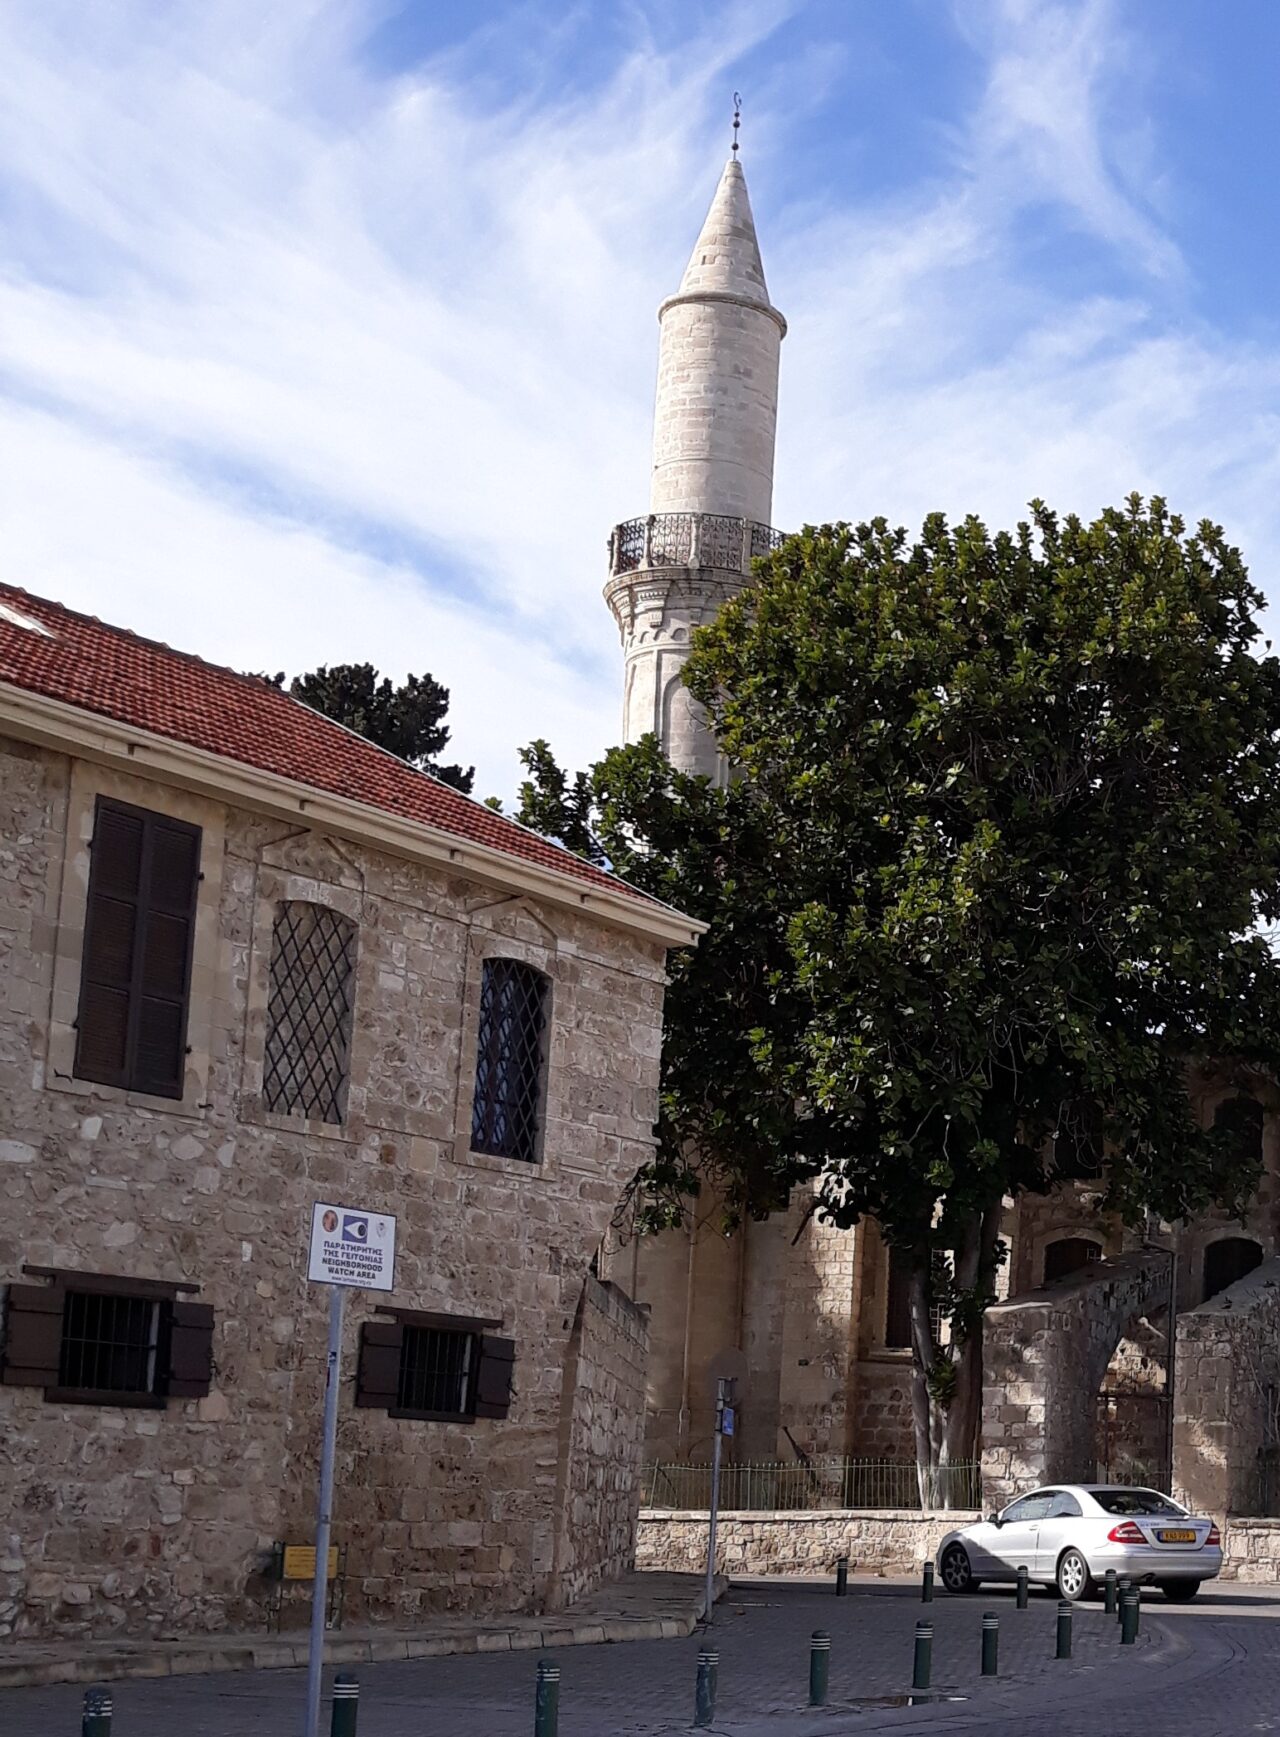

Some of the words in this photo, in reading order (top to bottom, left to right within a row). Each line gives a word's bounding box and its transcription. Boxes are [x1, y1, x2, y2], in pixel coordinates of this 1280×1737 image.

[323, 1240, 383, 1256] ΠΑΡΑΤΗΡΗΤΗΣ
[323, 1249, 339, 1258] ΤΗΣ
[341, 1252, 383, 1264] ΓΕΙΤΟΝΙΑΣ
[322, 1257, 383, 1272] NEIGHBORHOOD
[328, 1266, 355, 1276] WATCH
[357, 1271, 376, 1279] AREA
